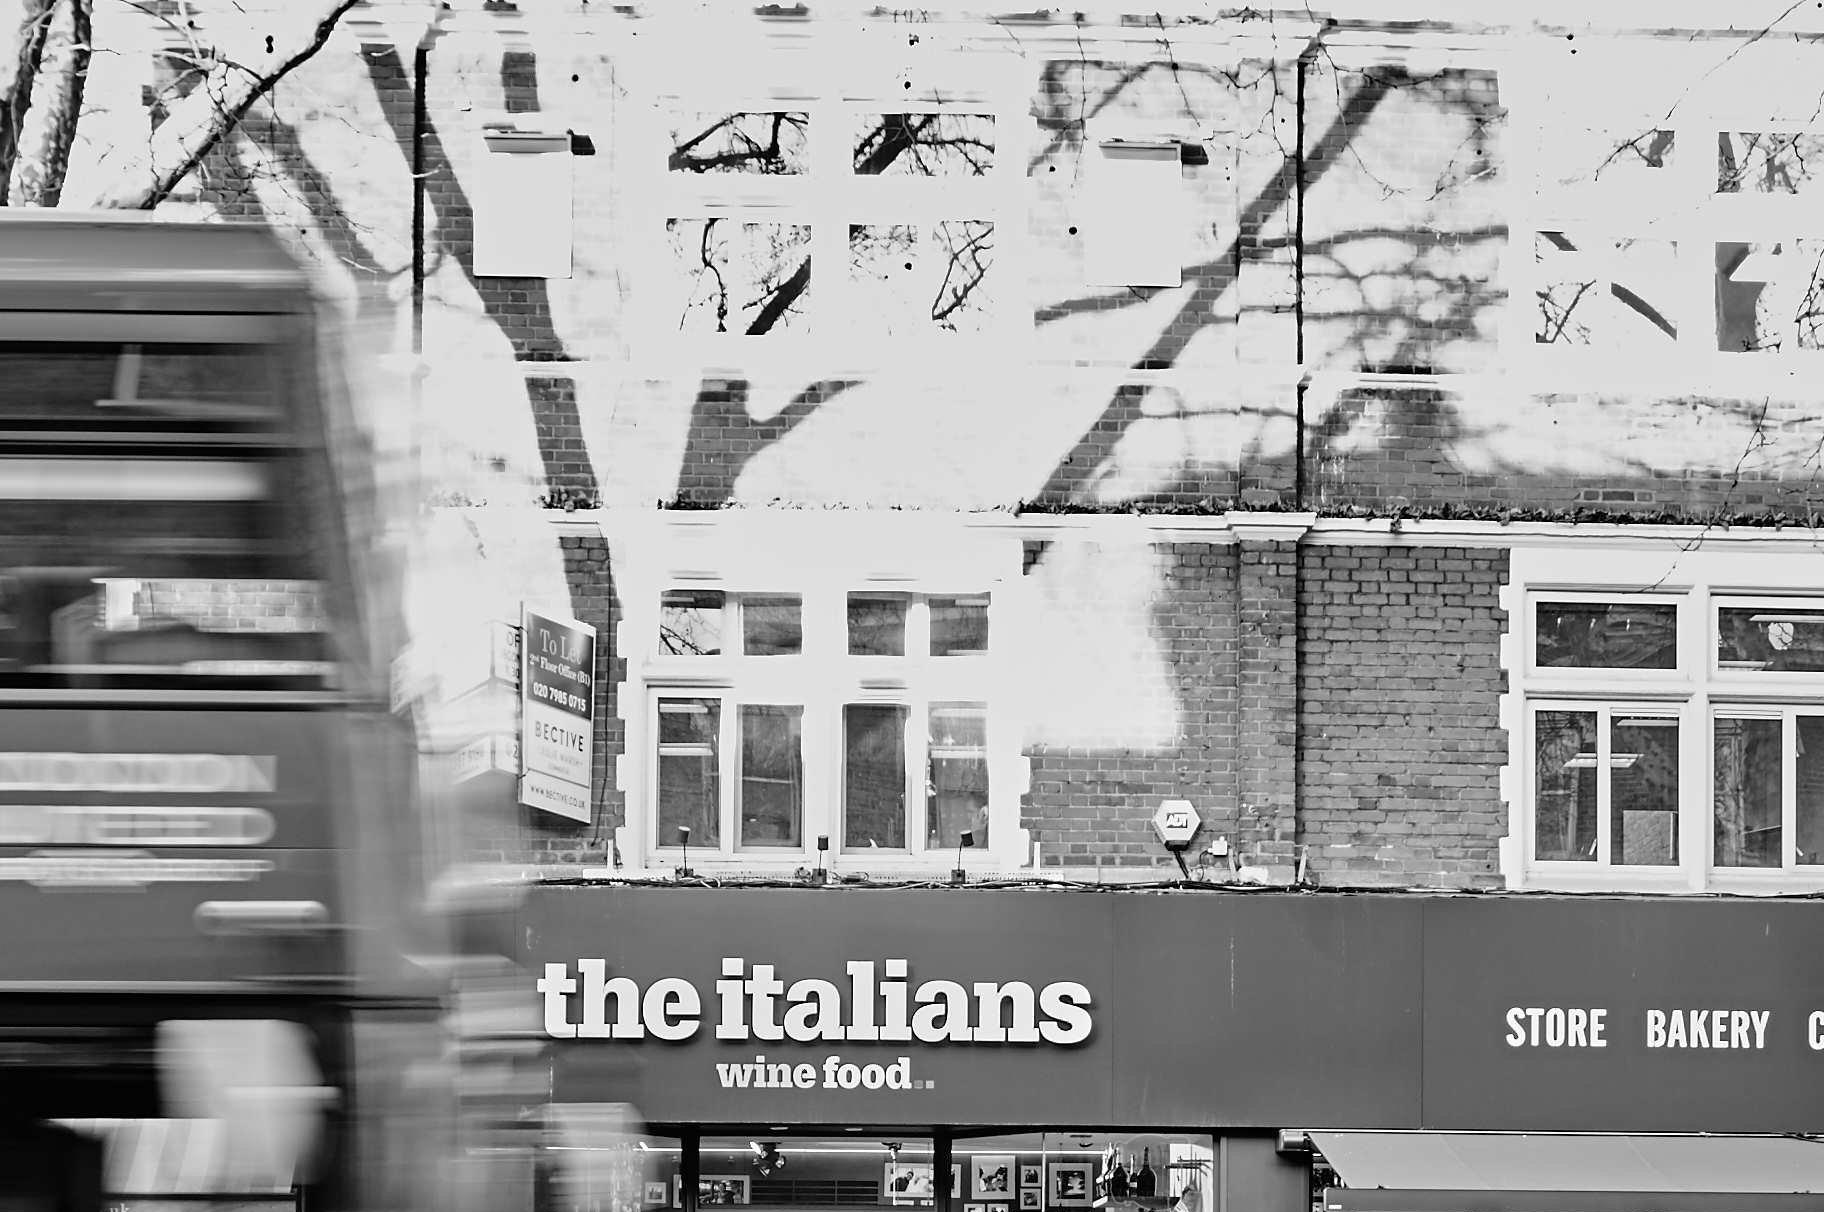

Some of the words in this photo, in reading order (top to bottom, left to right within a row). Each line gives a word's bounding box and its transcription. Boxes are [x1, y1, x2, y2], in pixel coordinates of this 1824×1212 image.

[539, 628, 557, 655] To
[533, 681, 549, 698] 020
[568, 694, 586, 712] 0715
[535, 720, 584, 752] BECTIVE
[536, 957, 702, 1040] the
[715, 956, 1093, 1044] italians
[1505, 1007, 1608, 1048] STORE
[1646, 1009, 1771, 1049] BAKERY
[715, 1055, 817, 1089] wine
